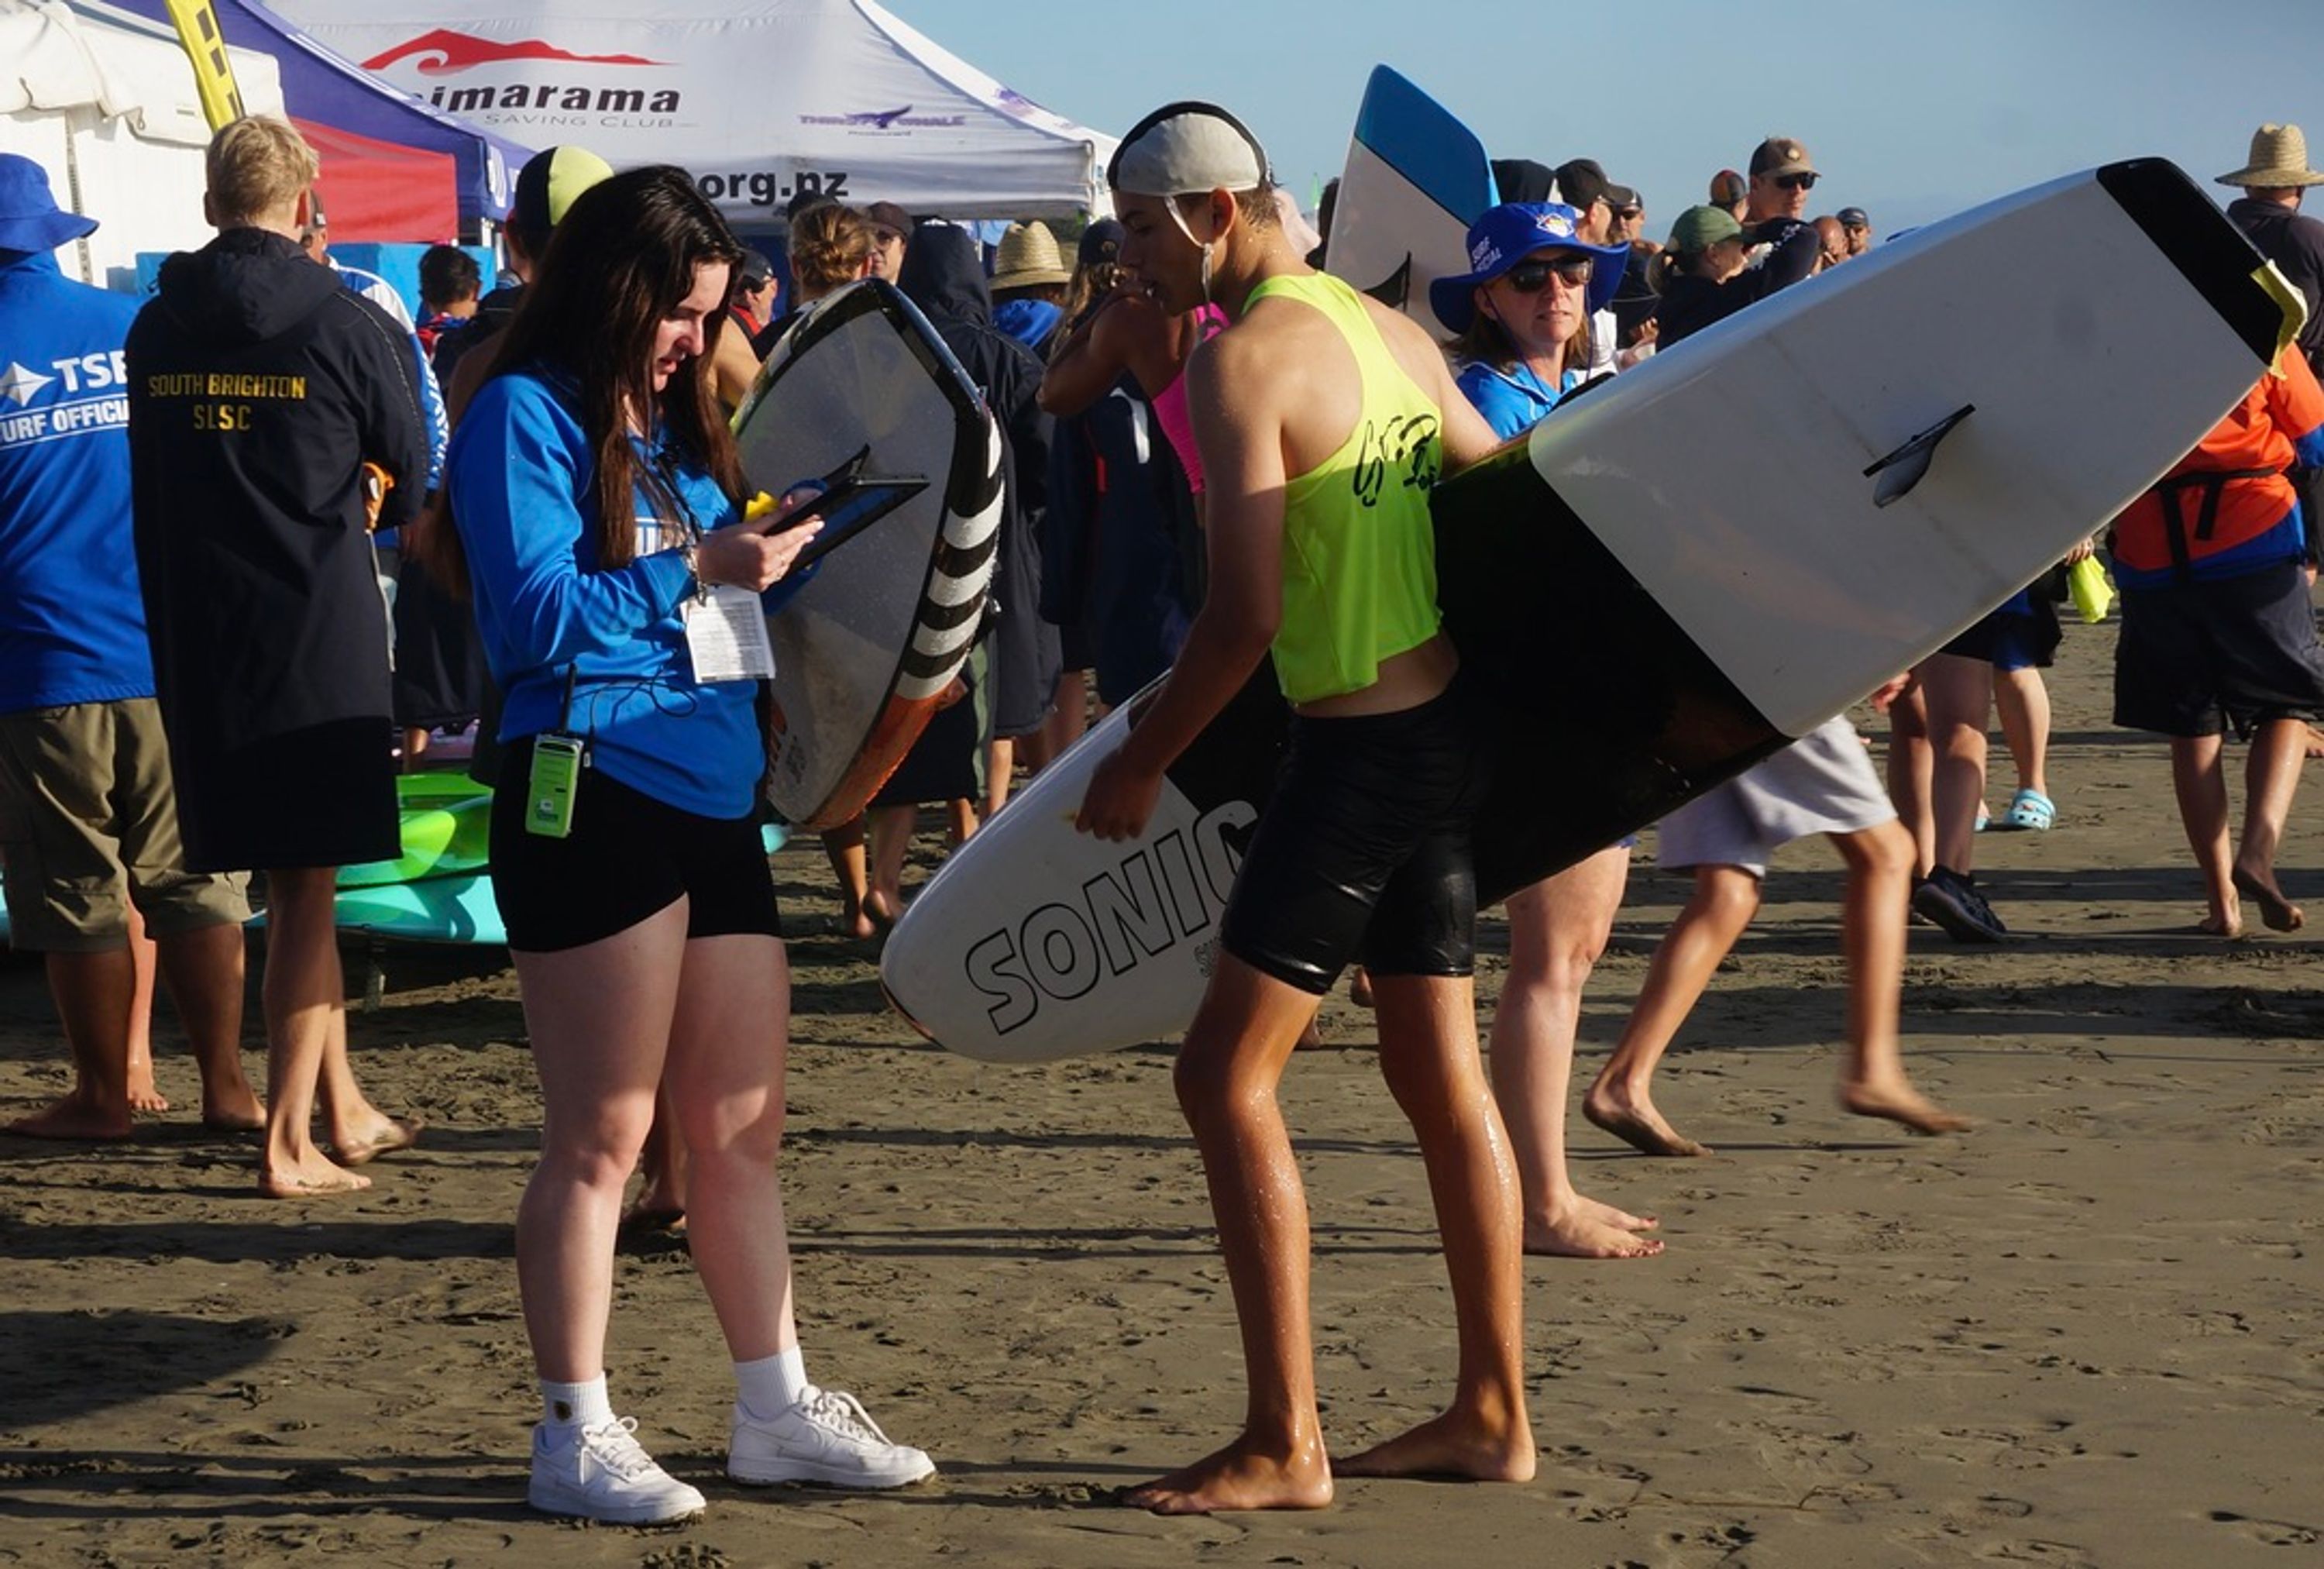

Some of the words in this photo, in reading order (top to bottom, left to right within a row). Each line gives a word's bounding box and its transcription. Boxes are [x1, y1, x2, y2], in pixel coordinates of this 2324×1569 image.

[413, 84, 680, 113] imarama
[484, 114, 587, 126] SAVING
[600, 117, 672, 128] CLUB
[148, 373, 205, 397] SOUTH
[207, 373, 306, 399] BRIGHTON
[0, 414, 47, 442] URF
[194, 404, 252, 431] SLSC
[965, 800, 1258, 1036] SONIC
